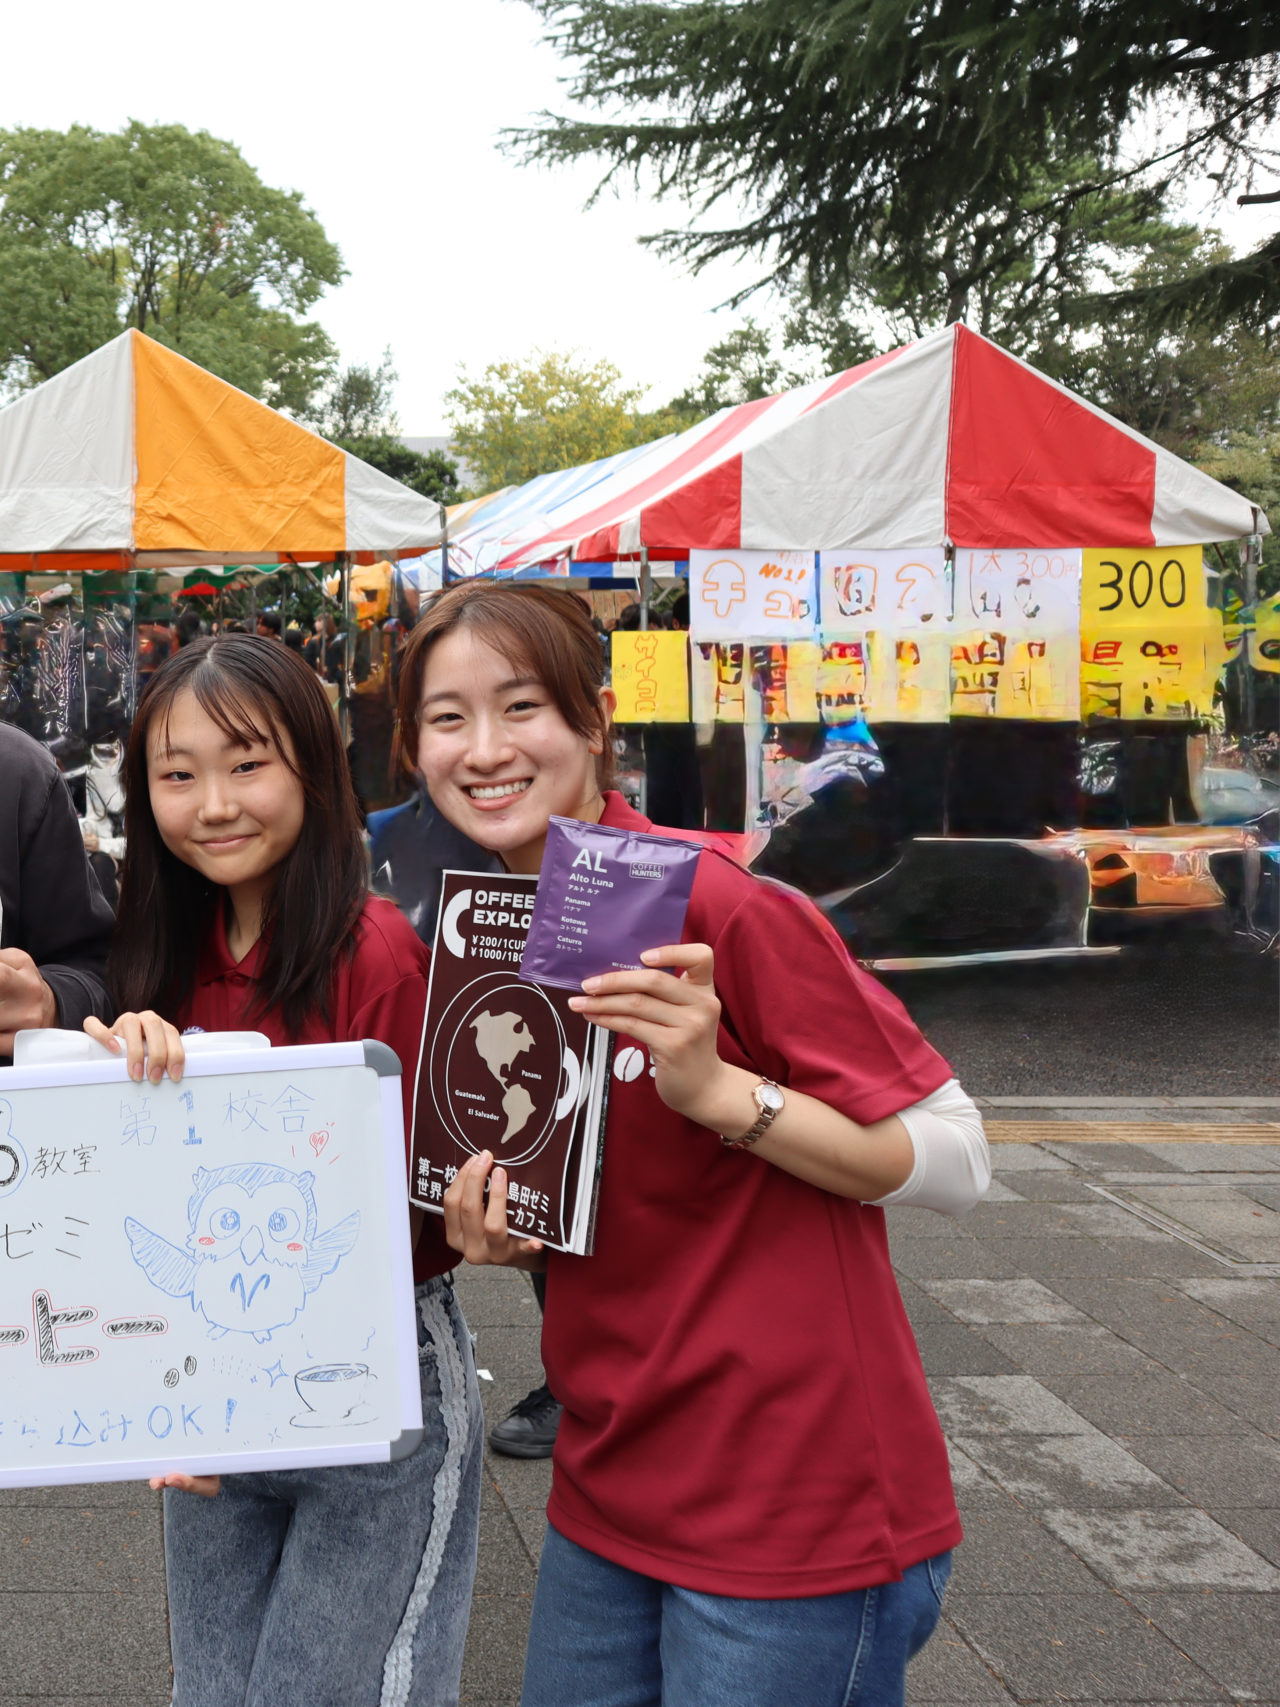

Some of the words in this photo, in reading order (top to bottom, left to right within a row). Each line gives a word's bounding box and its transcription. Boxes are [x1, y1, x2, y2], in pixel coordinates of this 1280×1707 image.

[1099, 560, 1185, 611] 300
[572, 848, 608, 874] AL
[632, 862, 663, 872] COFFEE
[631, 869, 662, 878] HUNTERS
[569, 872, 590, 884] Alto
[591, 875, 614, 888] Luna
[567, 884, 585, 893] アルト
[586, 886, 600, 895] ルナ
[564, 896, 591, 907] Panama
[561, 916, 587, 926] Kotowa
[557, 935, 583, 945] Caturra
[521, 1069, 542, 1081] Panama
[454, 1089, 486, 1102] Guatemala
[474, 1109, 500, 1121] Salvador
[507, 1181, 550, 1214] 島田ゼミ
